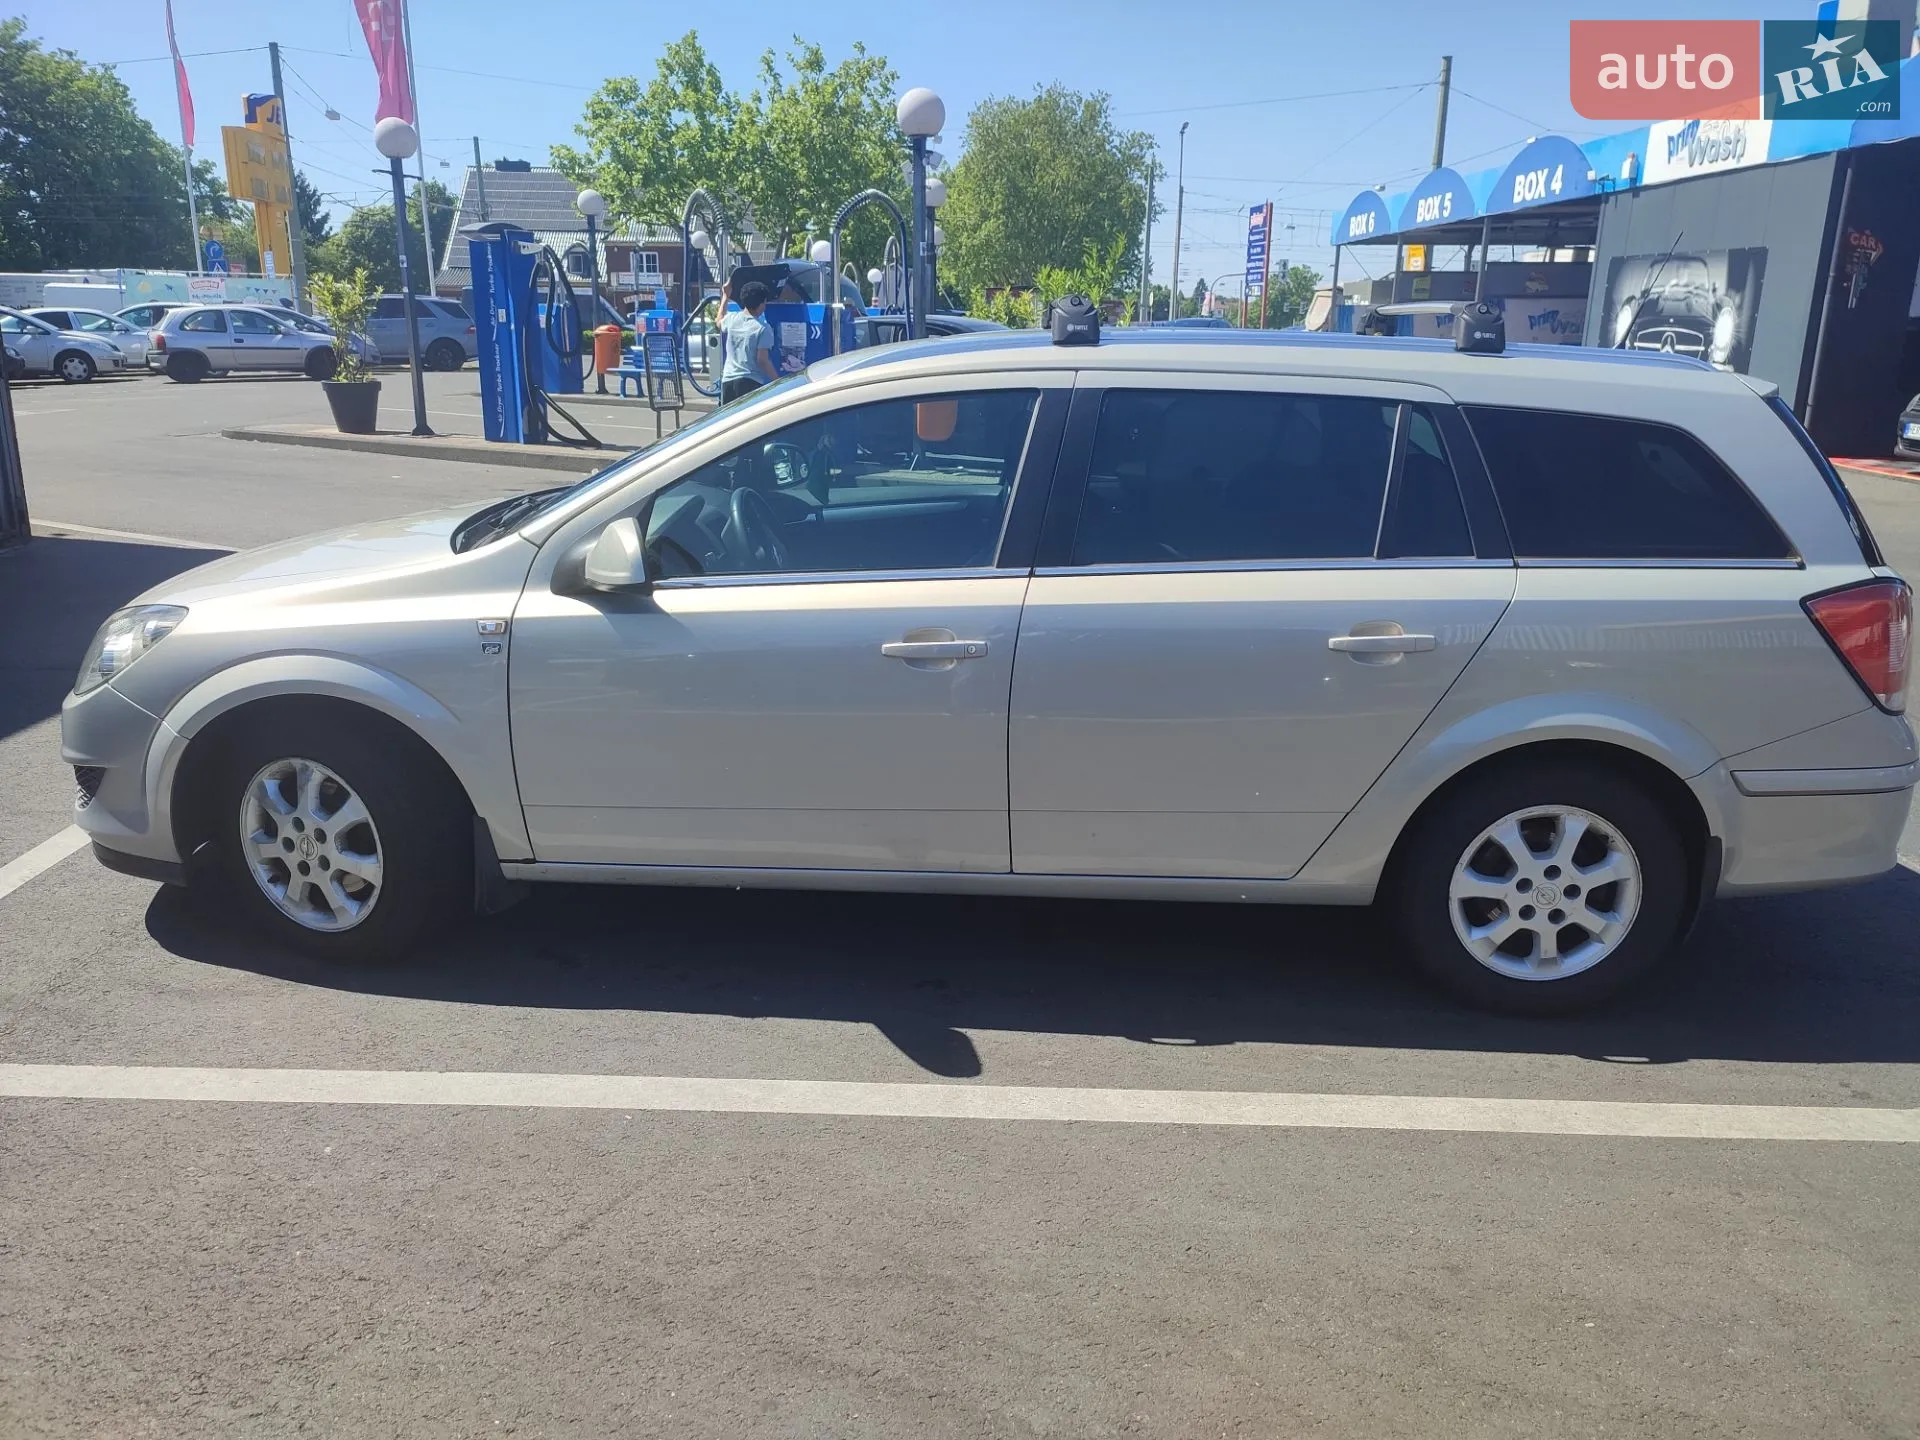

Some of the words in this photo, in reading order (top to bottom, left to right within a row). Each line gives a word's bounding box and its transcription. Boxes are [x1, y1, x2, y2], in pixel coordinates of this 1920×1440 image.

[1688, 126, 1747, 168] Wash
[1513, 168, 1549, 204] BOX
[1551, 164, 1564, 195] 4
[1349, 213, 1368, 237] BOX
[1368, 211, 1375, 233] 6
[1416, 195, 1442, 223] BOX
[1443, 192, 1452, 218] 5
